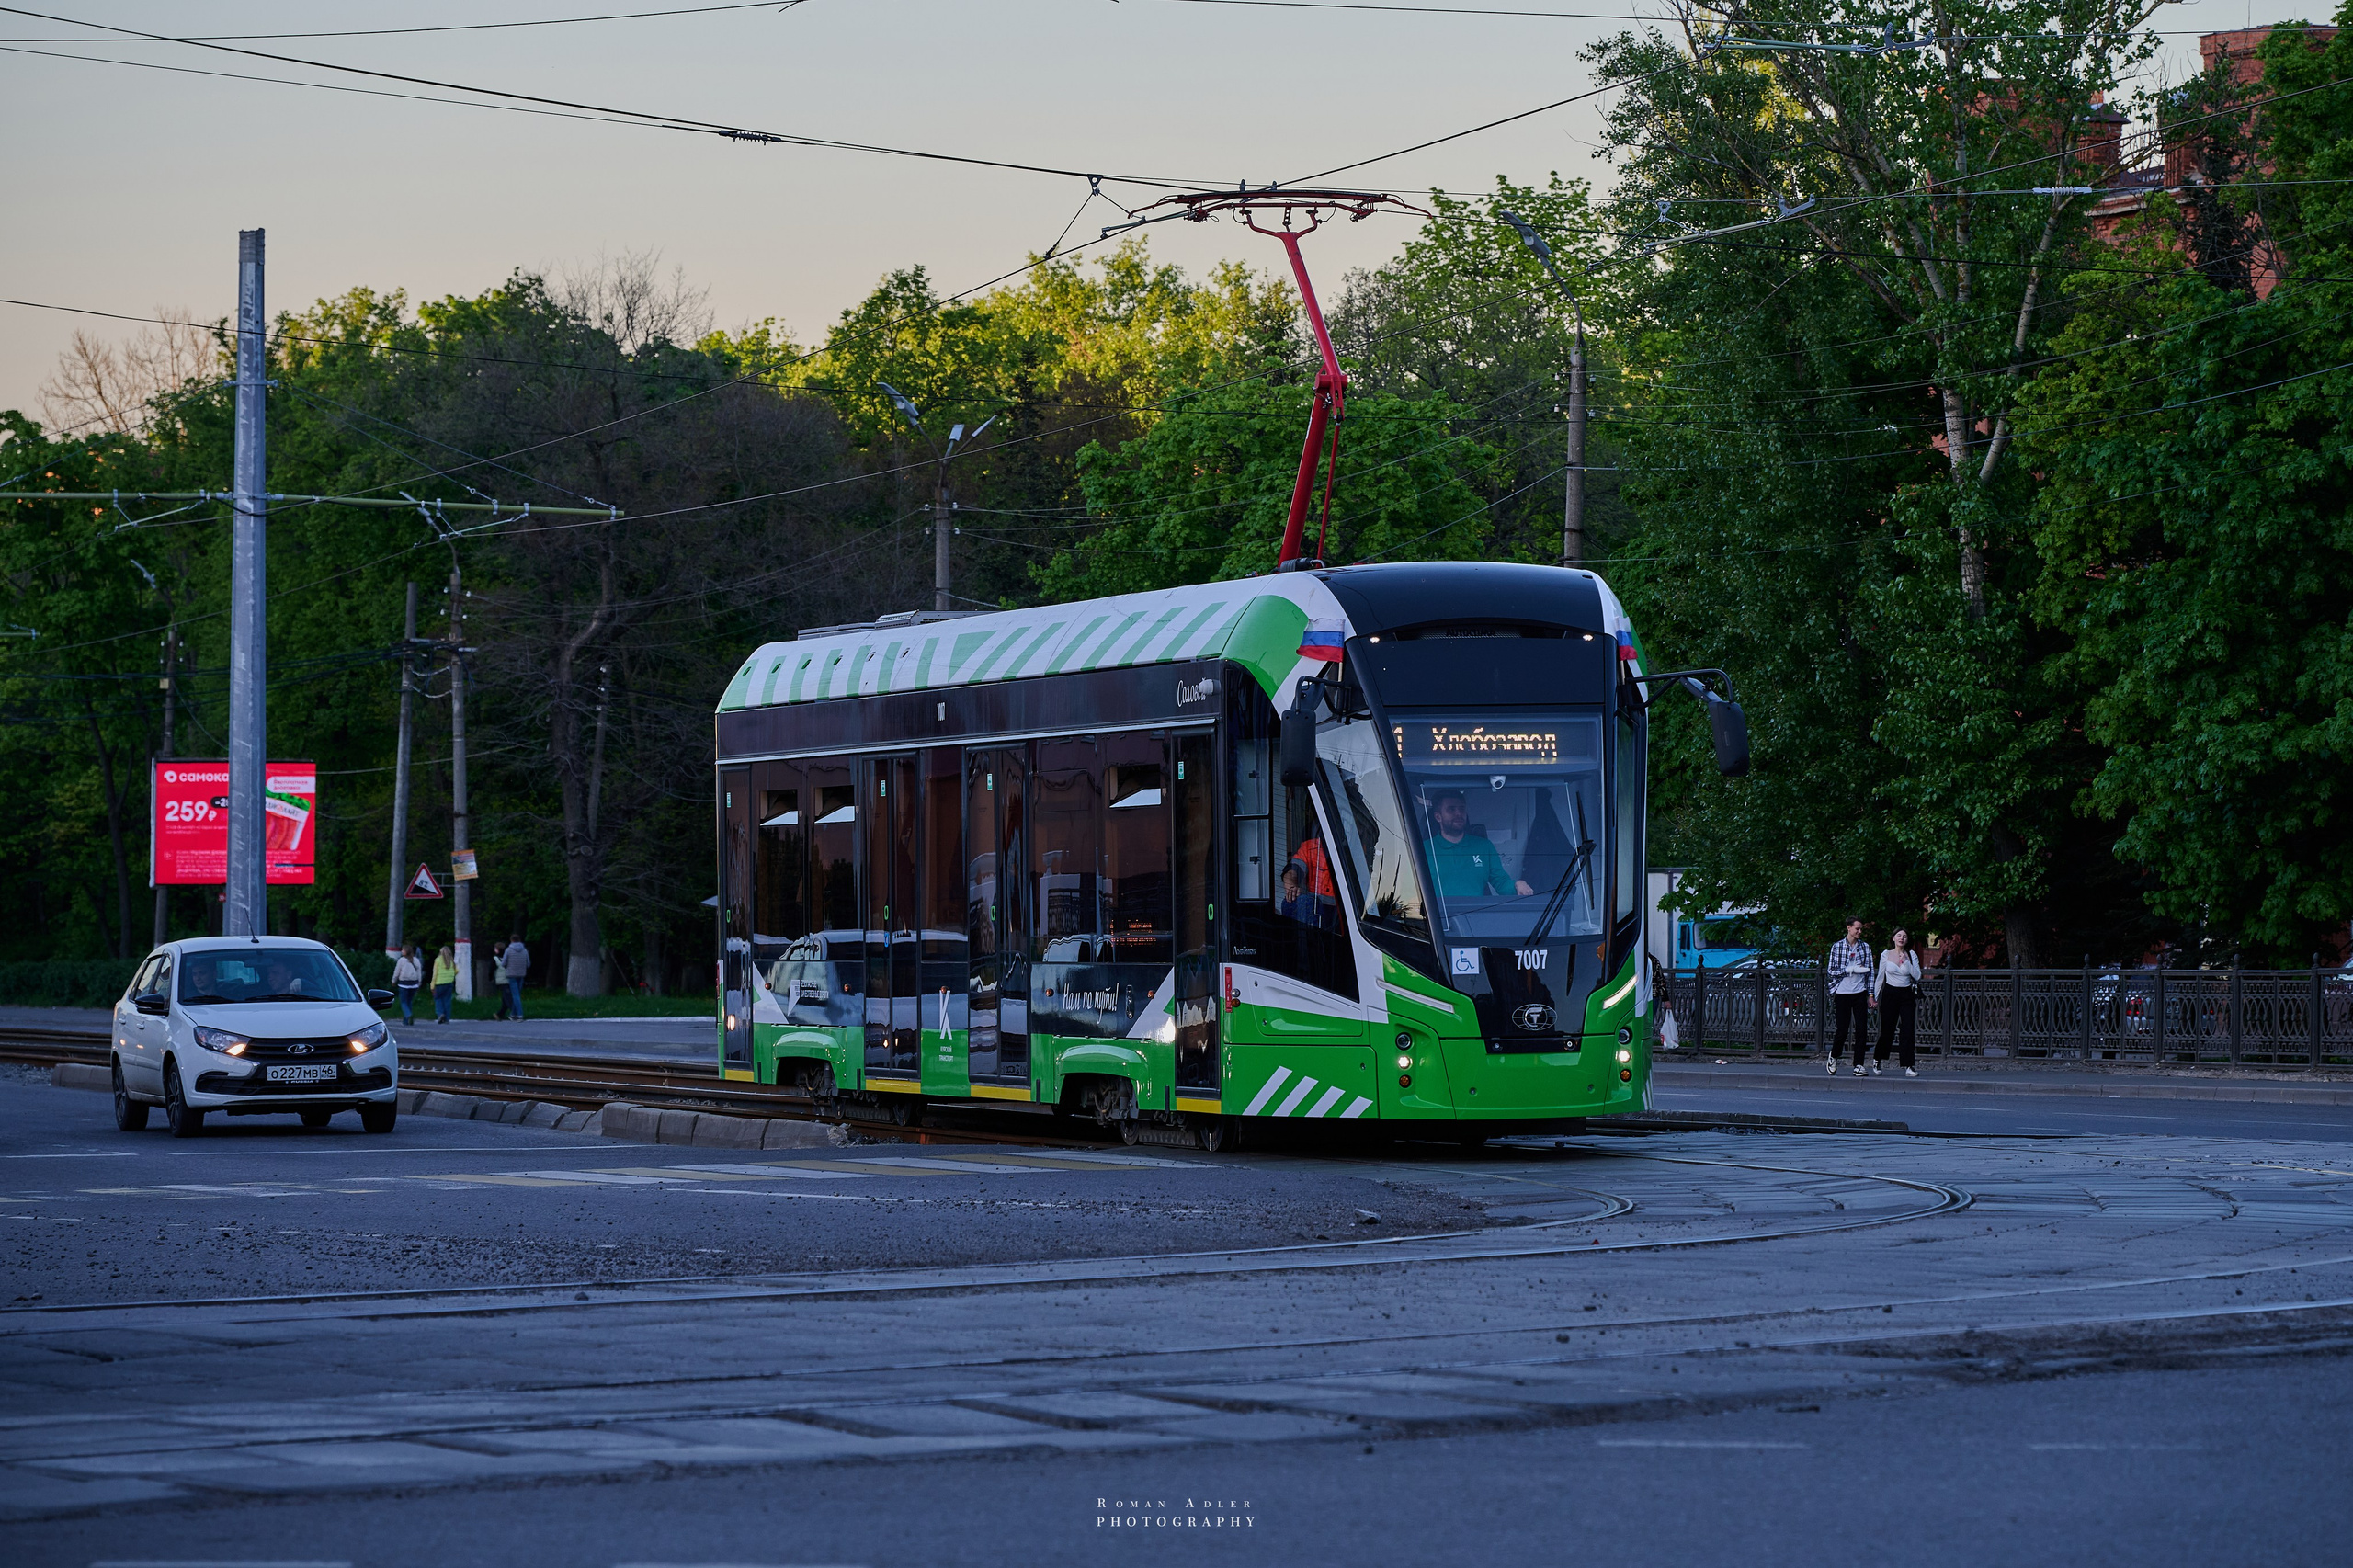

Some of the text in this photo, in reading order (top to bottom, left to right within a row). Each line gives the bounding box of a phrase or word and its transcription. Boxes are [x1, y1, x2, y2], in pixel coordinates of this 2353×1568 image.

[1431, 727, 1558, 757] Хлебозавод
[178, 772, 229, 782] самока
[1514, 949, 1548, 971] 7007
[1063, 982, 1120, 1025] Нам по пути!
[321, 1065, 333, 1074] 46
